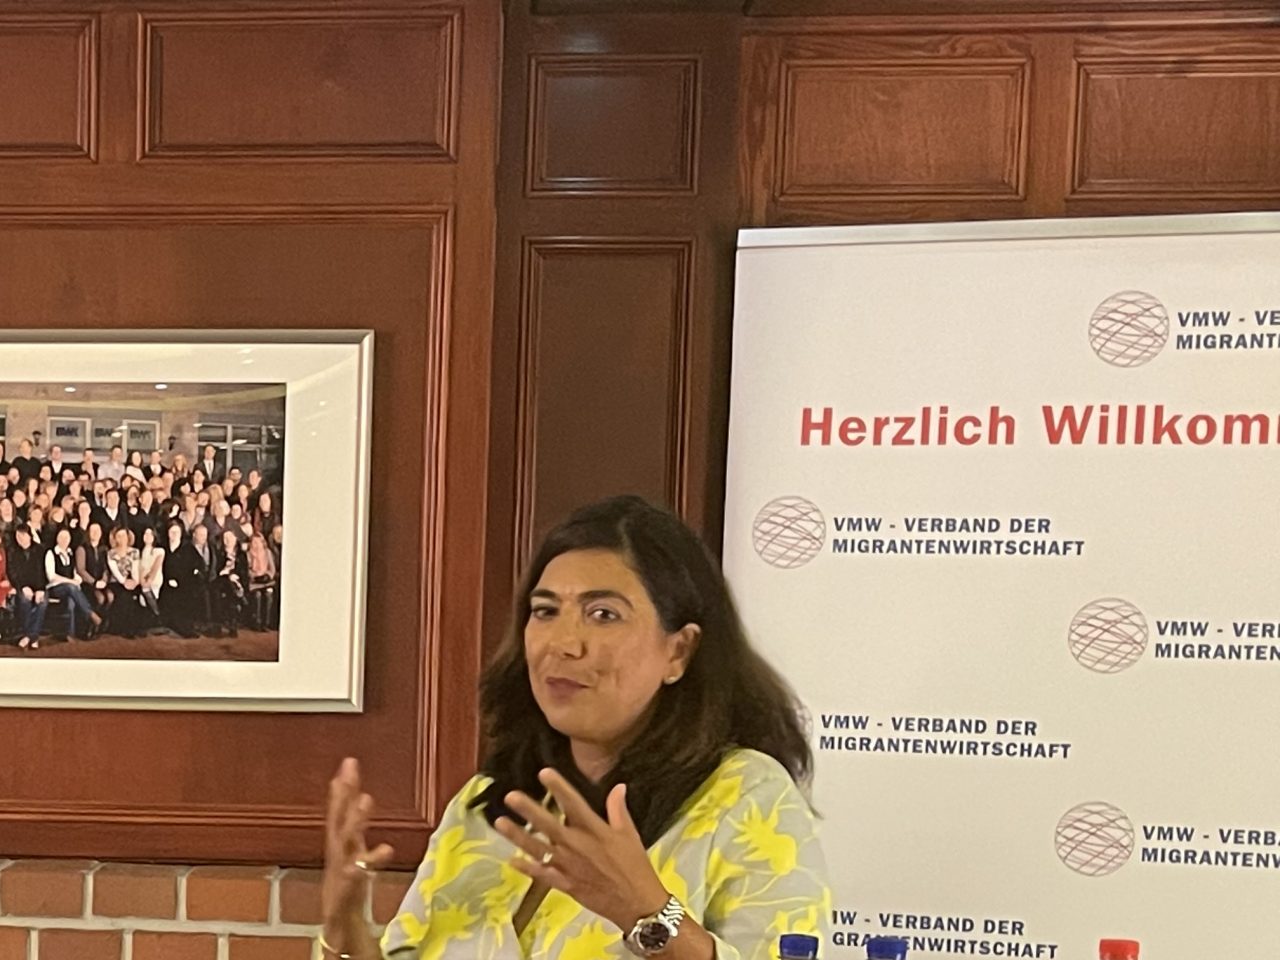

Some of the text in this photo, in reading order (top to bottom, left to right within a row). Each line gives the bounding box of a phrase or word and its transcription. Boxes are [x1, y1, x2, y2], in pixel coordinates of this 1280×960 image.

[1177, 311, 1231, 327] VMW
[1176, 333, 1280, 350] MIGRANT
[800, 404, 1280, 446] Herzlich Willkom
[833, 516, 882, 533] VMW
[904, 517, 1001, 534] VERBAND
[1010, 517, 1051, 534] DER
[832, 538, 1085, 556] MIGRANTENWIRTSCHAFT
[1156, 621, 1209, 637] VMW
[1232, 622, 1280, 638] VER
[821, 714, 869, 731] VMW
[891, 716, 988, 735] VERBAND
[996, 719, 1038, 737] DER
[819, 735, 1072, 759] MIGRANTENWIRTSCHAFT
[1142, 825, 1195, 842] VMW
[1219, 828, 1280, 846] VERB
[879, 912, 975, 933] VERBAND
[983, 919, 1025, 936] DER
